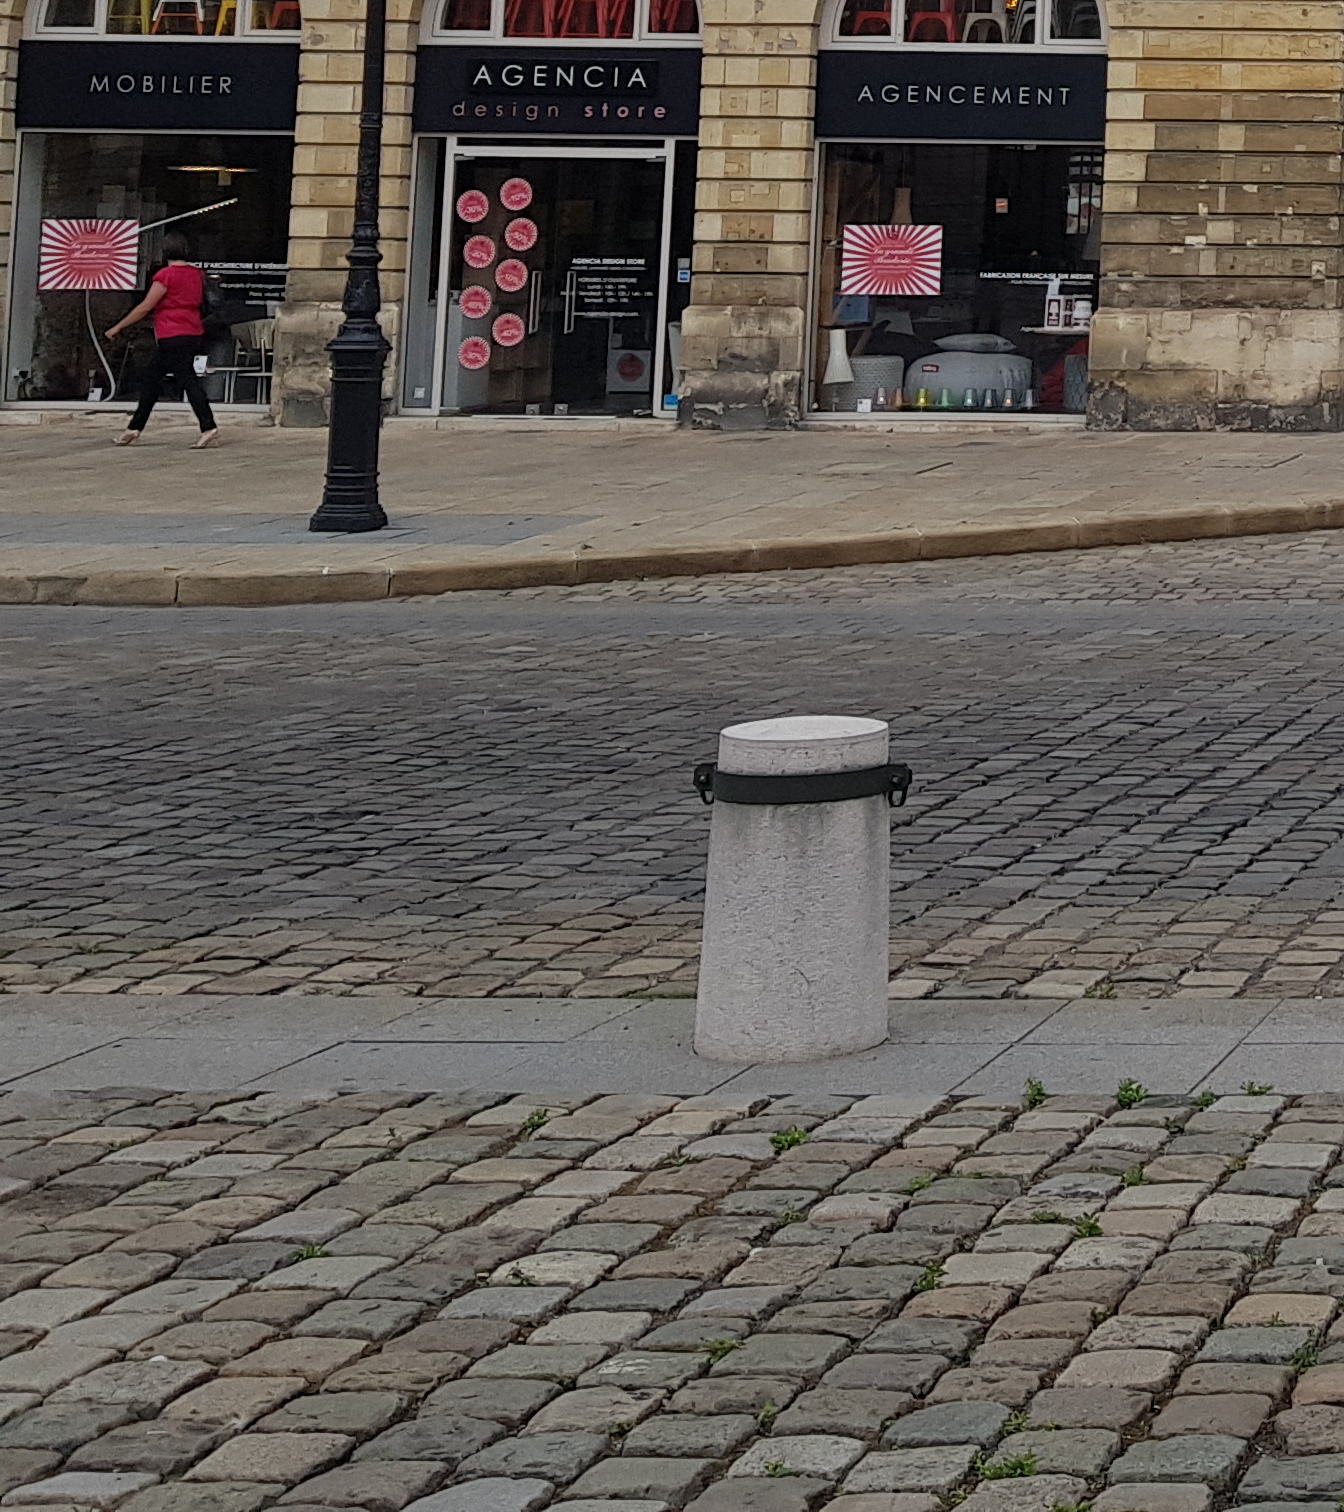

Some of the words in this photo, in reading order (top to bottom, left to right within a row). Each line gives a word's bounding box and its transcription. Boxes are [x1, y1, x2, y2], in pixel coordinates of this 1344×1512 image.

[89, 74, 233, 94] MOBILIER
[472, 64, 648, 88] AGENCIA
[857, 84, 1071, 106] AGENCEMENT
[452, 101, 560, 122] design
[583, 102, 668, 119] store
